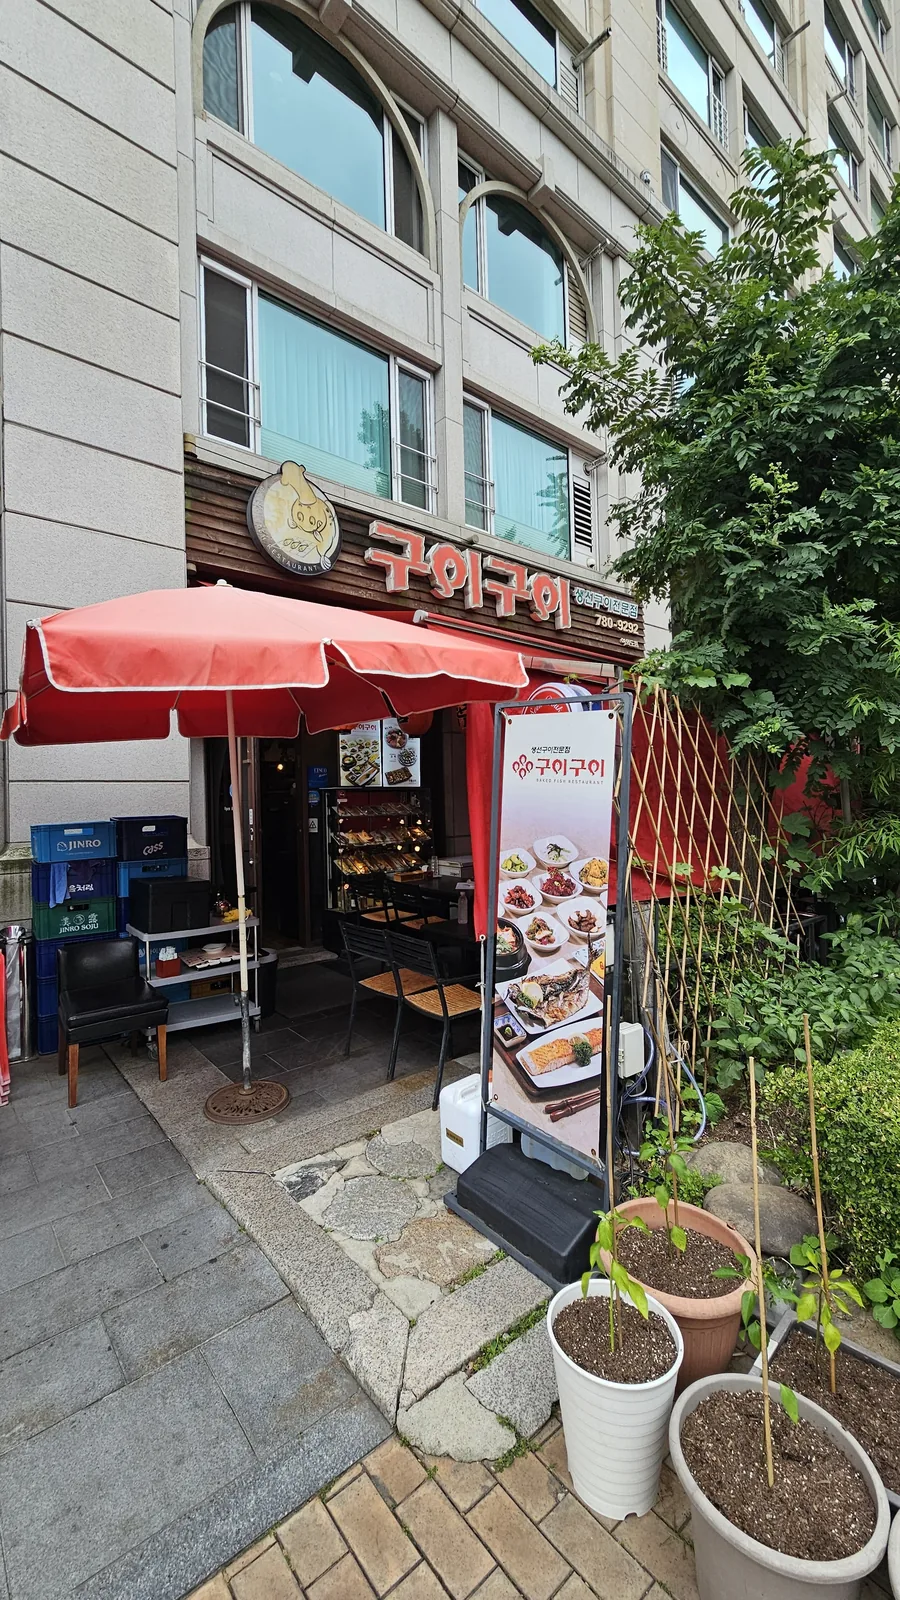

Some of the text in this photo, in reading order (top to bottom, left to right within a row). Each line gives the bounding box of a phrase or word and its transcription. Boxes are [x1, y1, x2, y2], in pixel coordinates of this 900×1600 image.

[266, 543, 318, 572] RESTAURANT
[364, 520, 572, 630] 구이구이
[573, 587, 639, 619] 생선구이전문점
[595, 614, 639, 635] 780-9292
[531, 746, 571, 754] 생선구이전문점
[535, 758, 605, 777] 구이구이
[68, 839, 101, 851] JINRO
[68, 883, 94, 893] 음처럼
[59, 922, 99, 934] JINRO SOJU
